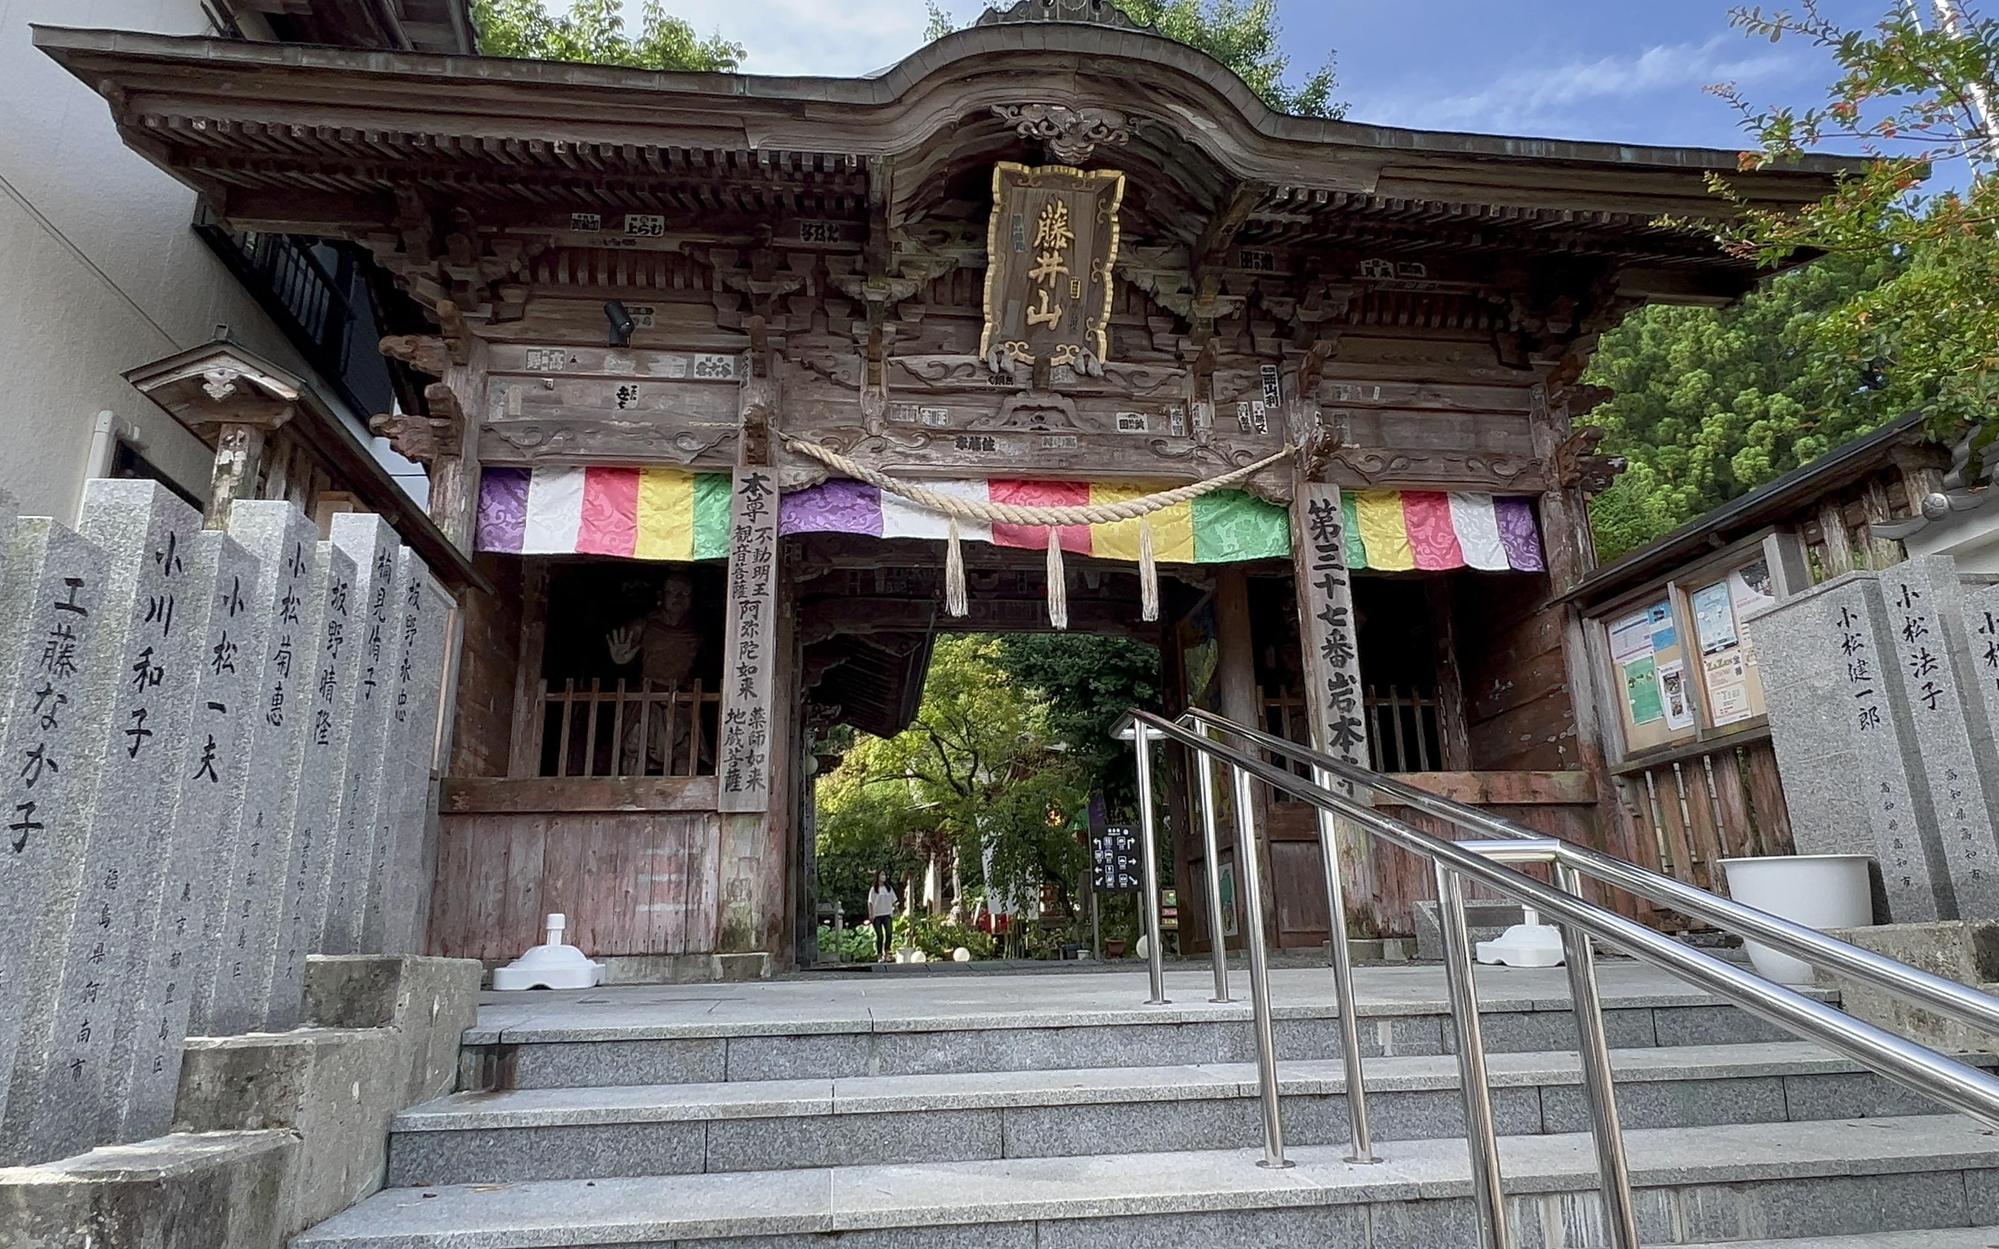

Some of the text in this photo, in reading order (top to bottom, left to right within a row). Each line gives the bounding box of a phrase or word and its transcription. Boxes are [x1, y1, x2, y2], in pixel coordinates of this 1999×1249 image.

[1026, 200, 1075, 331] 藤井山
[738, 472, 773, 523] 本尊
[731, 524, 753, 600] 観音菩薩
[751, 526, 773, 597] 不動明王
[124, 530, 183, 759] 小川和子
[193, 576, 244, 783] 小松一夫
[735, 599, 762, 701] 阿弥陀如来
[1837, 606, 1881, 731] 小松健一郎
[1897, 583, 1944, 710] 小松法子
[8, 577, 87, 853] 工藤なか子
[724, 707, 748, 793] 地蔵菩薩
[745, 706, 767, 793] 薬師如来
